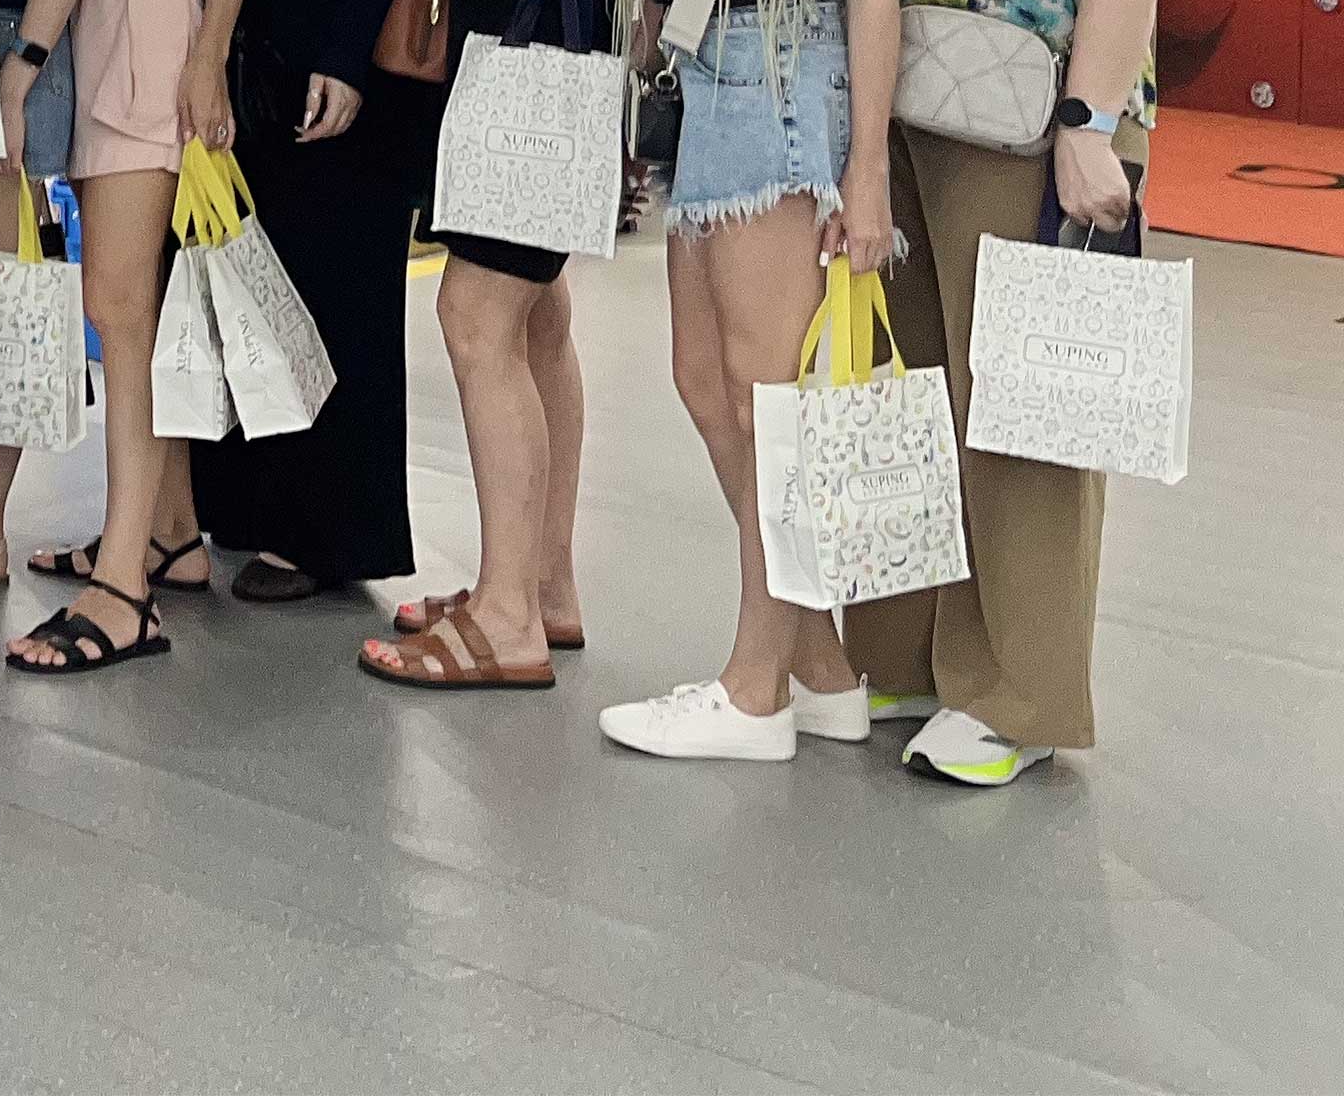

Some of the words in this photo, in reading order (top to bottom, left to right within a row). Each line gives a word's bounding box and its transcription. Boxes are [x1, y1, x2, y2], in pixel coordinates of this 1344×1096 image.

[502, 132, 560, 151] XUPING
[1043, 342, 1108, 363] XUPING
[861, 471, 909, 489] XUPING
